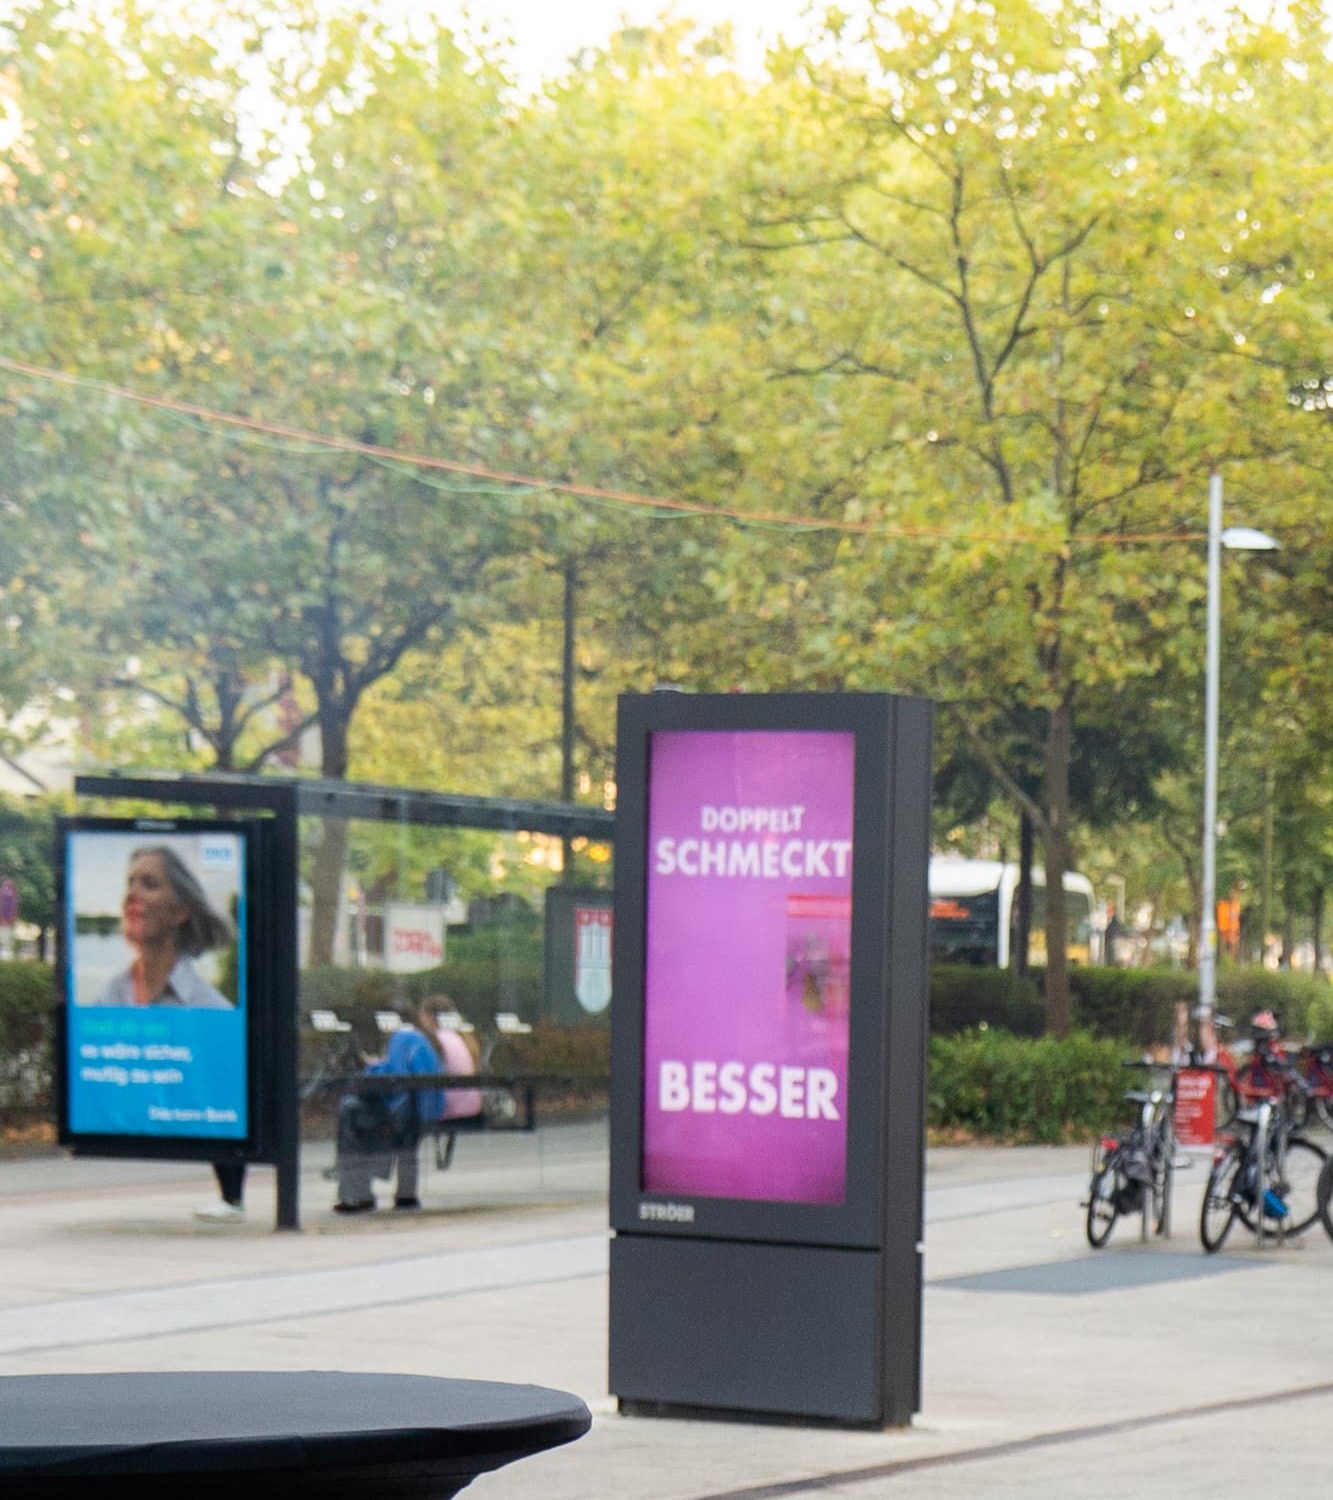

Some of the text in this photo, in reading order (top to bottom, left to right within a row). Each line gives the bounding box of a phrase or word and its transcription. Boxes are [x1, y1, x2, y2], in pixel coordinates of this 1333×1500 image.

[701, 804, 805, 833] DOPPELT
[656, 837, 852, 878] SCHMECKT
[659, 1060, 841, 1121] BESSER
